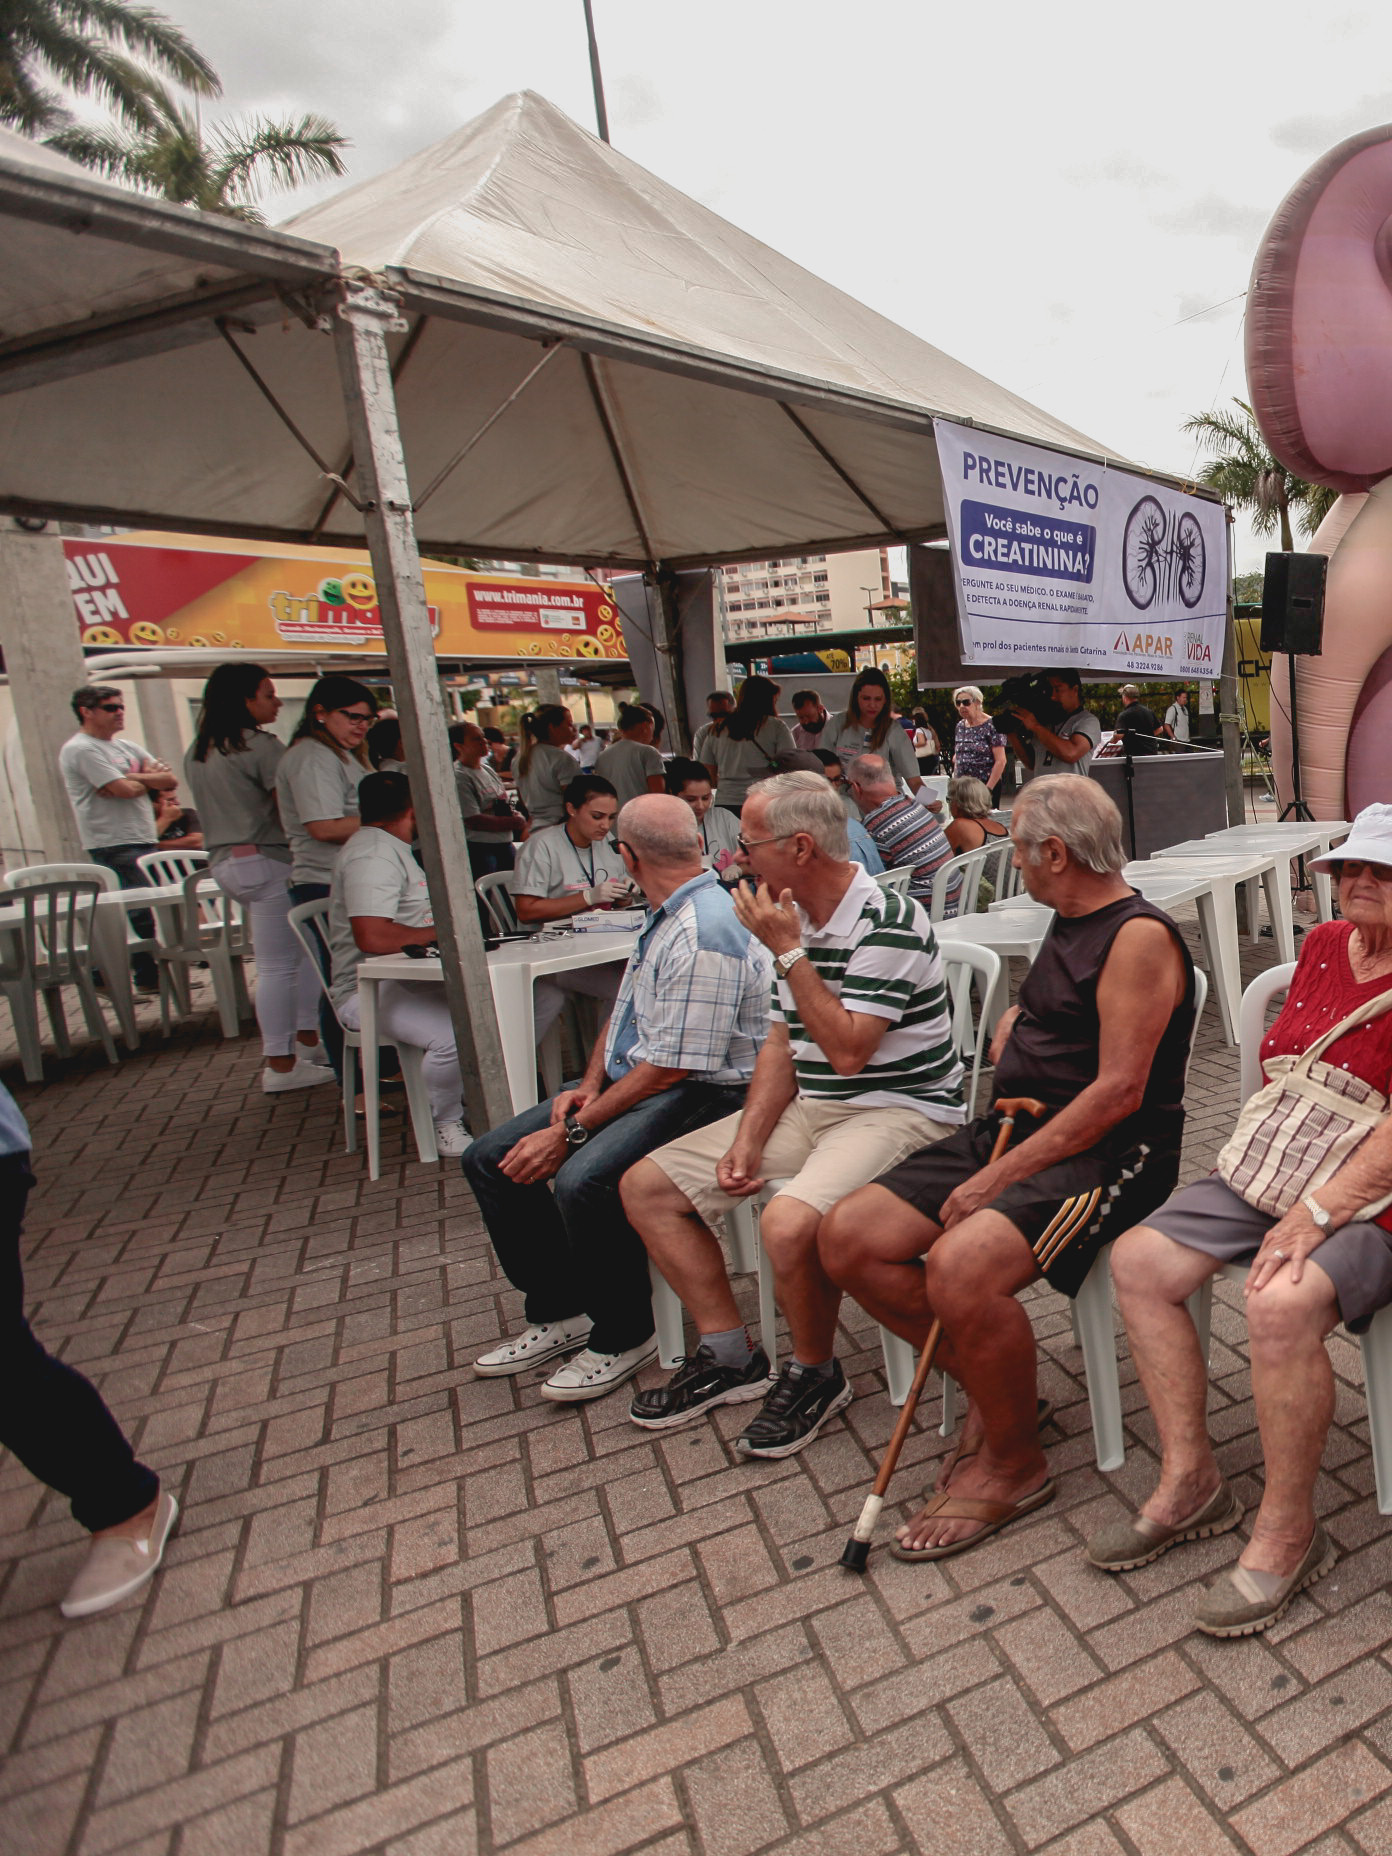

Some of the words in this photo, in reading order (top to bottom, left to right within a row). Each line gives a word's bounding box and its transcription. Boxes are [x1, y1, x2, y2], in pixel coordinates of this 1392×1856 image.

[963, 451, 1099, 510] PREVENÇÃO
[984, 512, 1013, 532] Você
[1015, 520, 1041, 538] sabe
[1043, 528, 1051, 539] o
[1053, 529, 1074, 545] que
[1076, 531, 1083, 545] é
[969, 533, 1090, 575] CREATININA?
[961, 578, 994, 591] ERGUNTE
[995, 581, 1005, 592] AO
[1006, 583, 1019, 593] SEU
[1020, 584, 1048, 597] MÉDICO.
[1049, 588, 1055, 597] O
[1056, 589, 1076, 600] EXAME
[473, 590, 584, 608] www.trimania.com.br
[972, 594, 1001, 606] DETECTA
[1002, 598, 1008, 606] A
[1008, 599, 1037, 610] DOENÇA
[1038, 602, 1059, 611] RENAL
[1132, 633, 1173, 656] APAR
[1186, 632, 1204, 644] RENAL
[982, 640, 997, 651] prol
[998, 640, 1012, 650] dos
[1013, 641, 1047, 653] pacientes
[1080, 646, 1107, 656] Catarina
[1187, 643, 1211, 662] VIDA
[831, 659, 848, 670] 70%
[1127, 661, 1134, 669] 48
